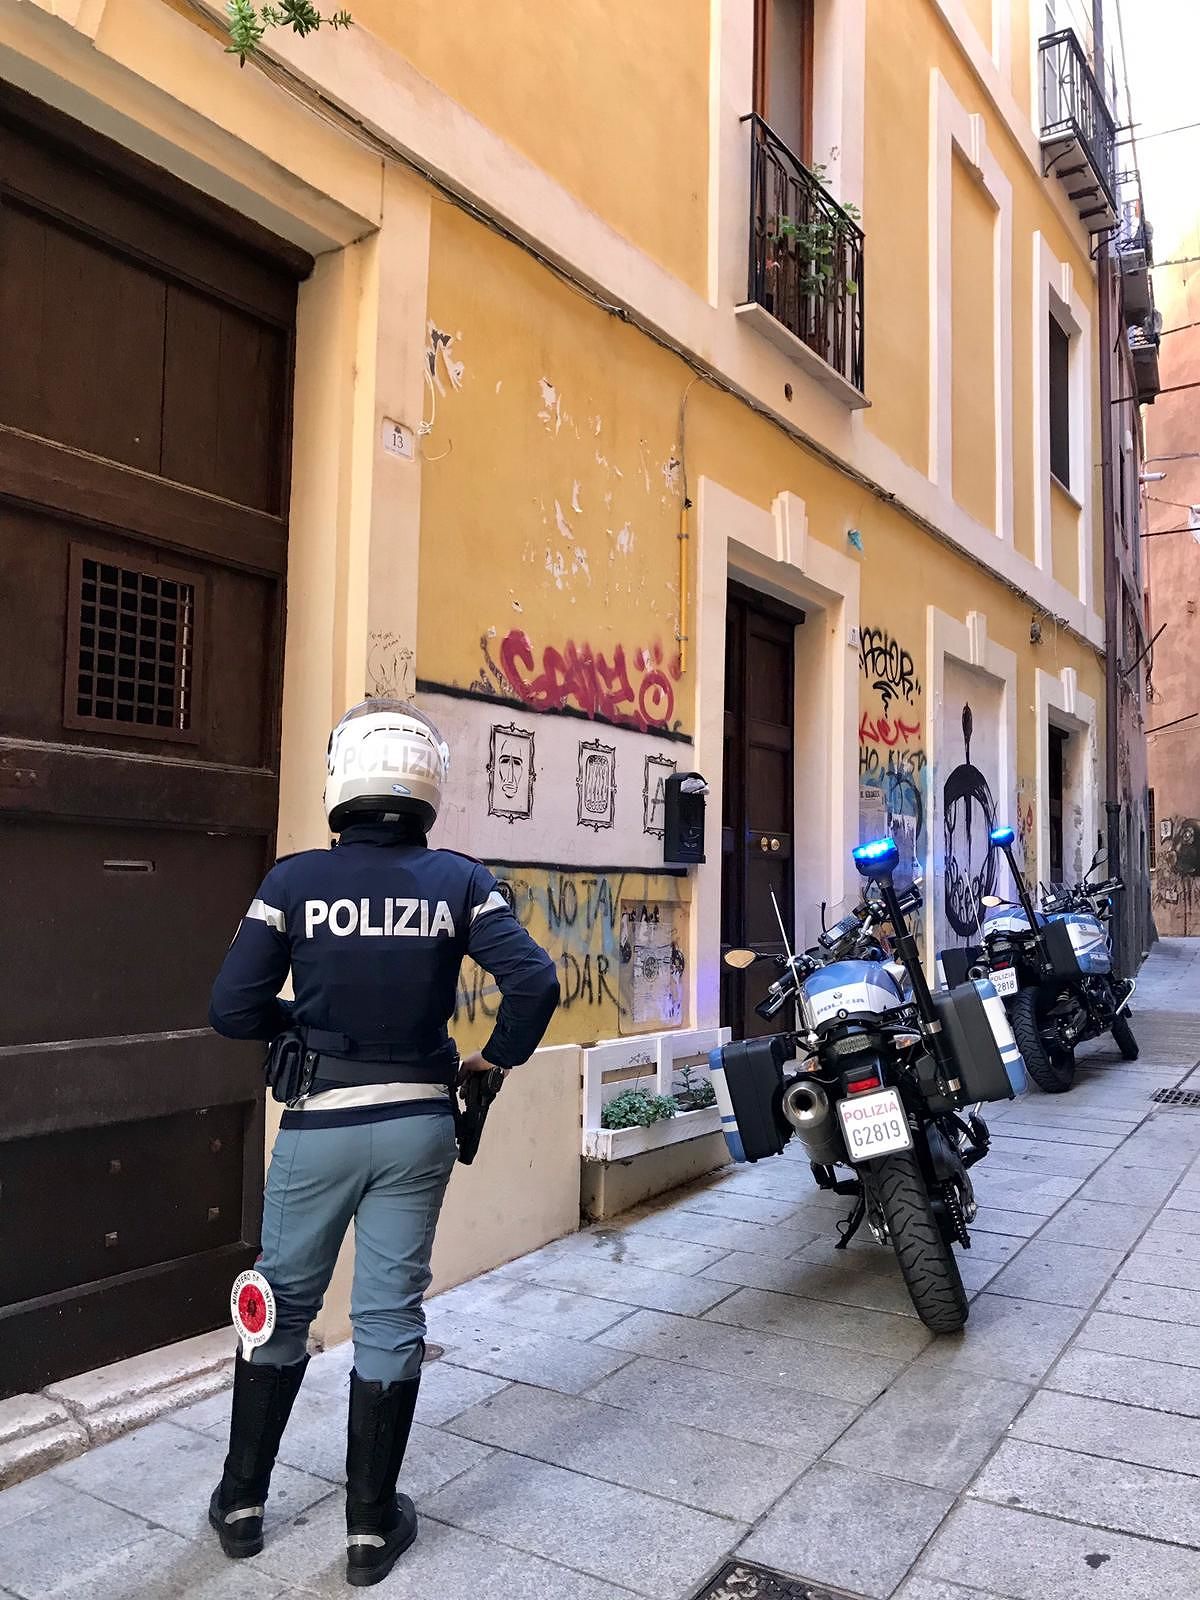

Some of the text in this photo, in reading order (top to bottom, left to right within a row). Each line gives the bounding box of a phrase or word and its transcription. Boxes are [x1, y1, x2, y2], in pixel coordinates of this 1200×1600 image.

[392, 433, 403, 449] 13
[304, 898, 456, 938] POLIZIA
[995, 980, 1015, 993] 2818
[843, 1101, 898, 1123] POLIZIA
[852, 1120, 901, 1147] G2819
[233, 1273, 251, 1306] MINISTERO
